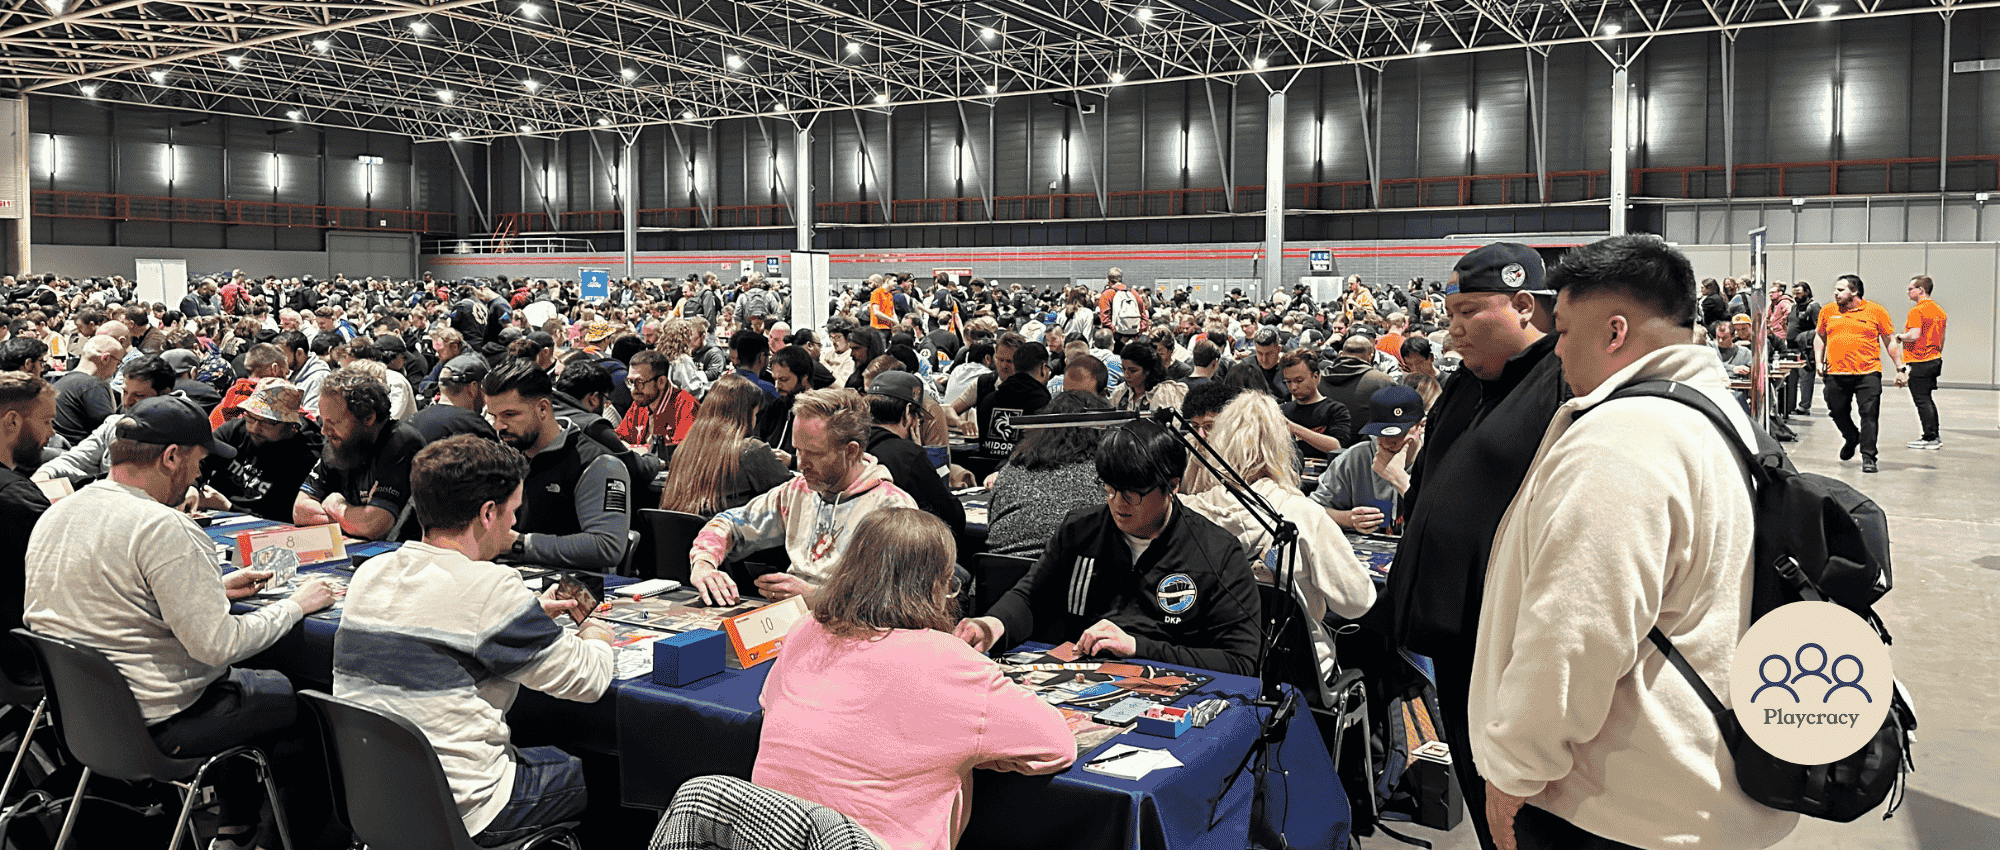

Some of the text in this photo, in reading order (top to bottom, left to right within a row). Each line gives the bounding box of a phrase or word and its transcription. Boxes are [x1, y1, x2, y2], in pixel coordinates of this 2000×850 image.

[286, 535, 295, 549] 8
[760, 617, 774, 634] 10
[1164, 615, 1182, 624] DKP
